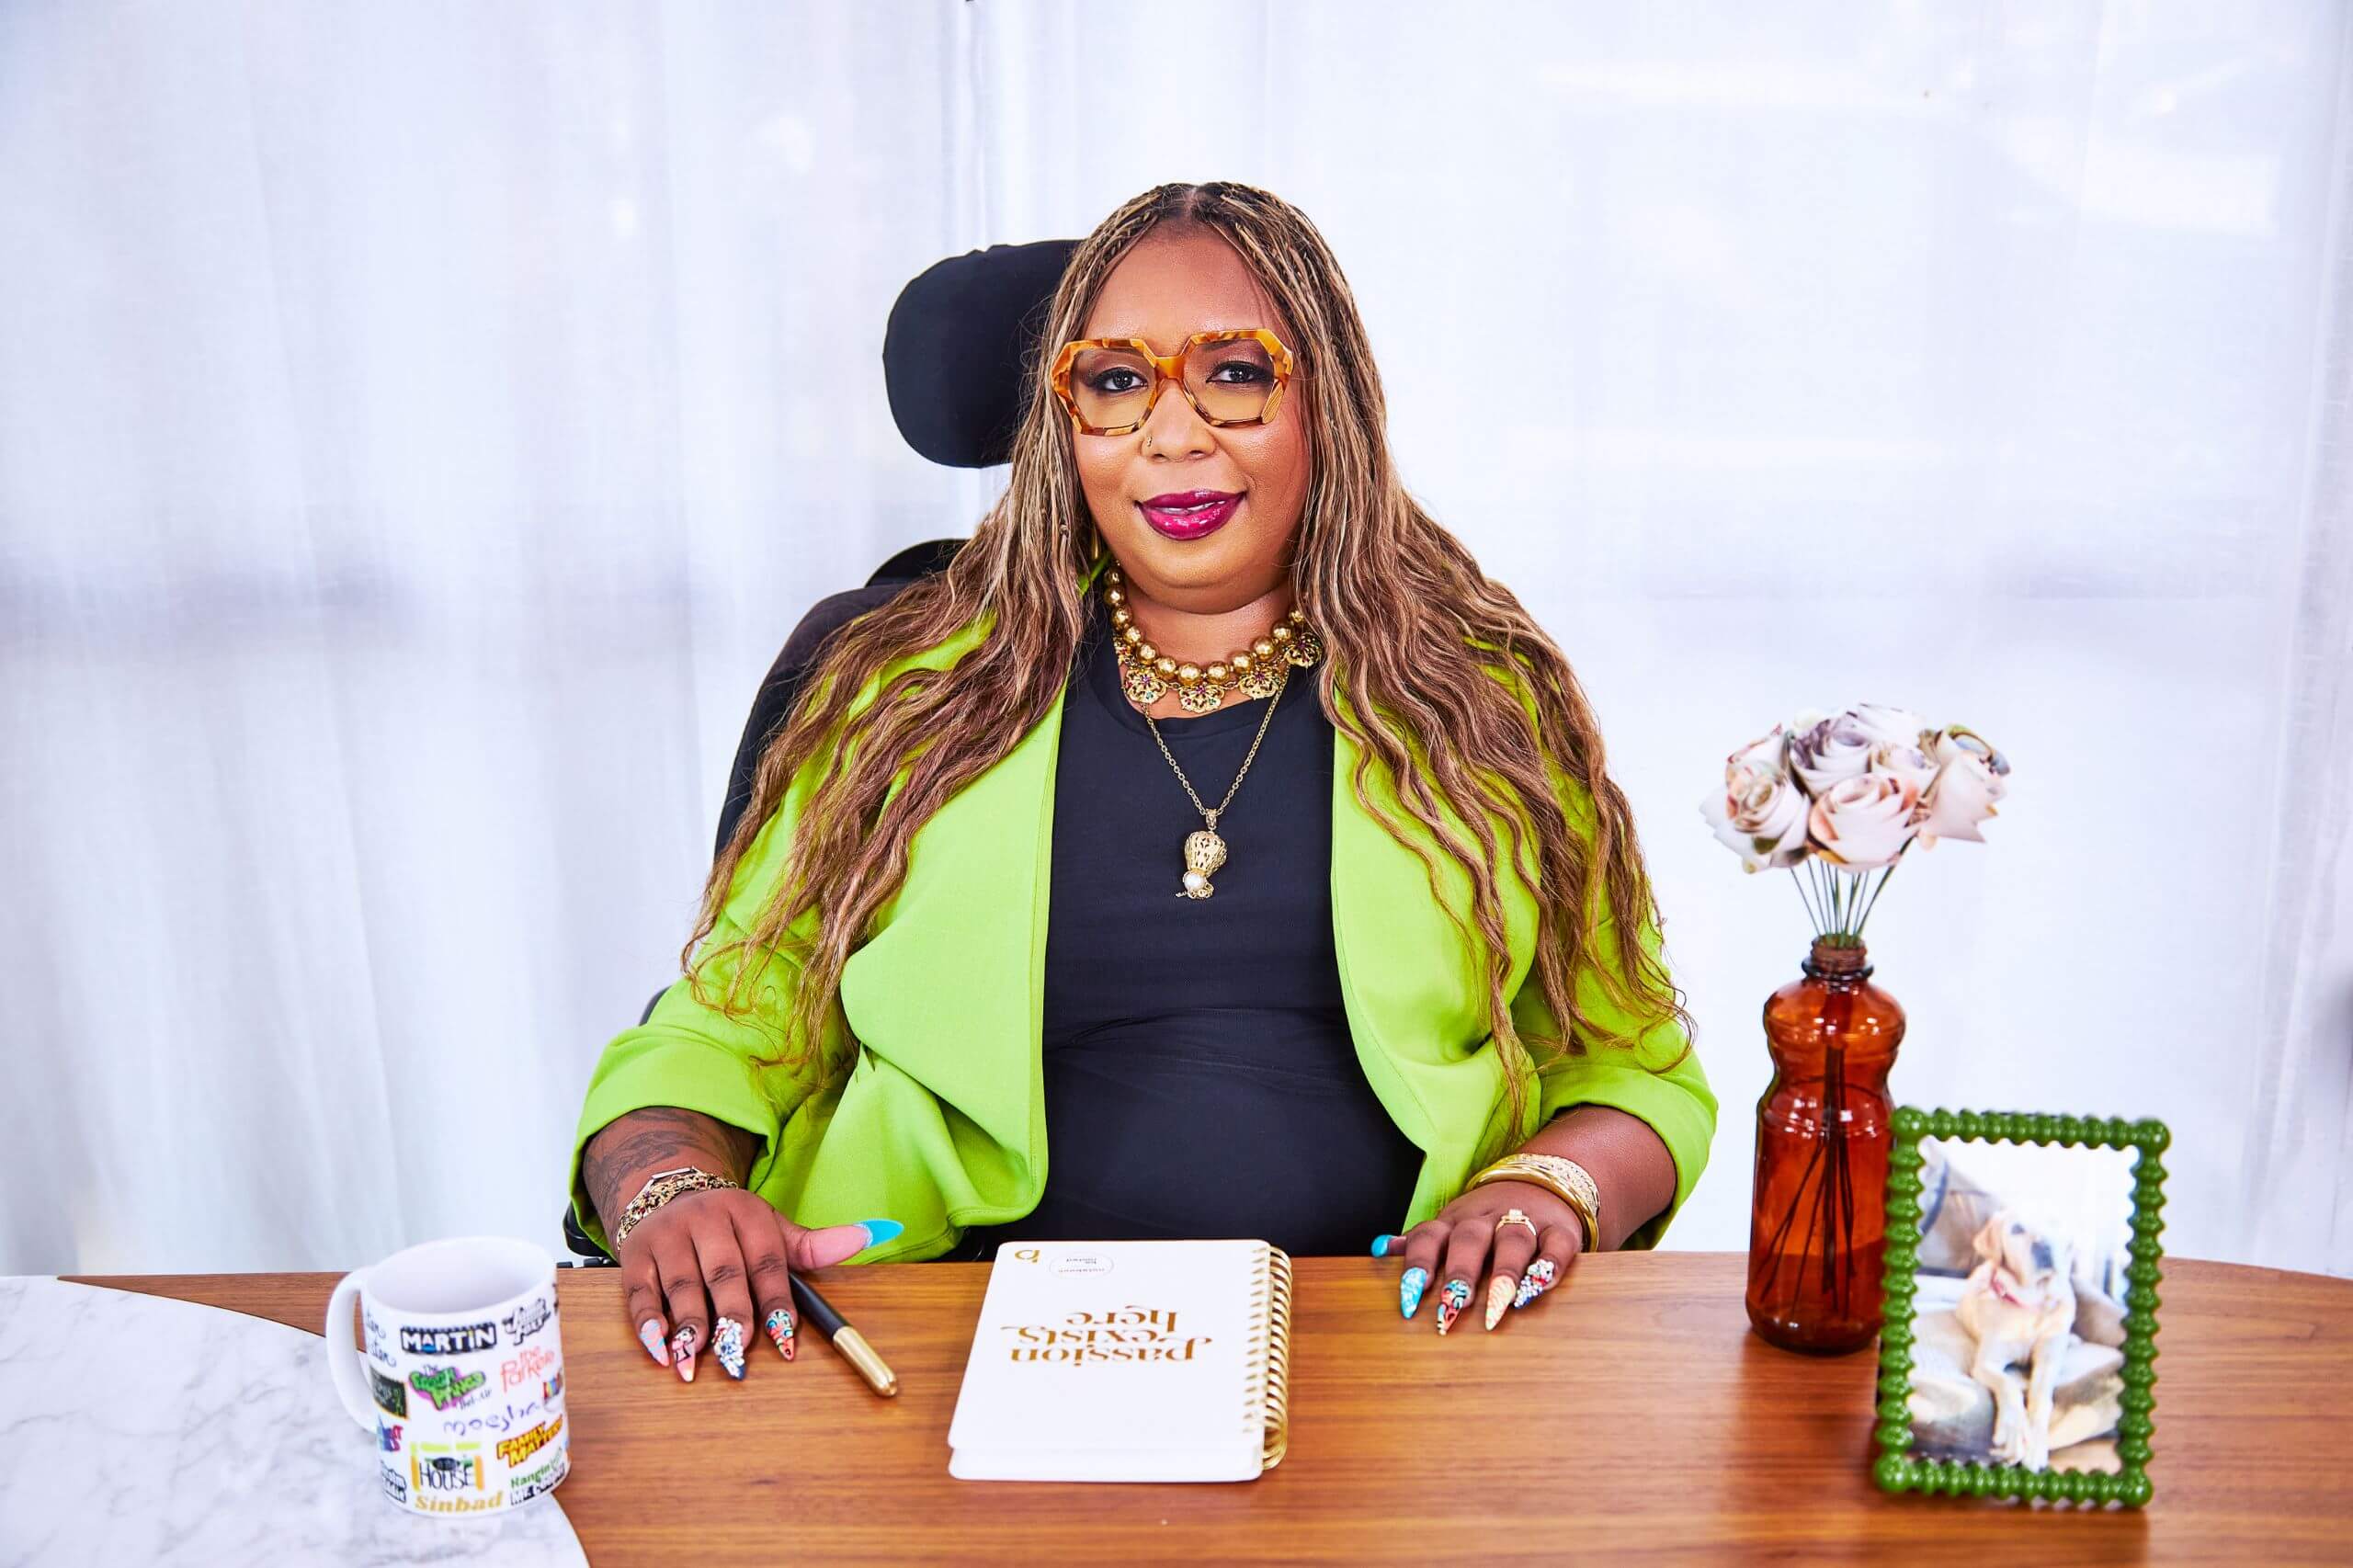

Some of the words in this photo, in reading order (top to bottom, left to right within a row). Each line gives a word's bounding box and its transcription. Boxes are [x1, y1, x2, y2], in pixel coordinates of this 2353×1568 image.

[1066, 1306, 1178, 1334] here
[402, 1326, 496, 1353] MARTIN
[1001, 1325, 1158, 1348] exists
[1009, 1336, 1212, 1367] passion
[419, 1462, 475, 1491] HOUSE
[415, 1490, 504, 1512] Sinbad
